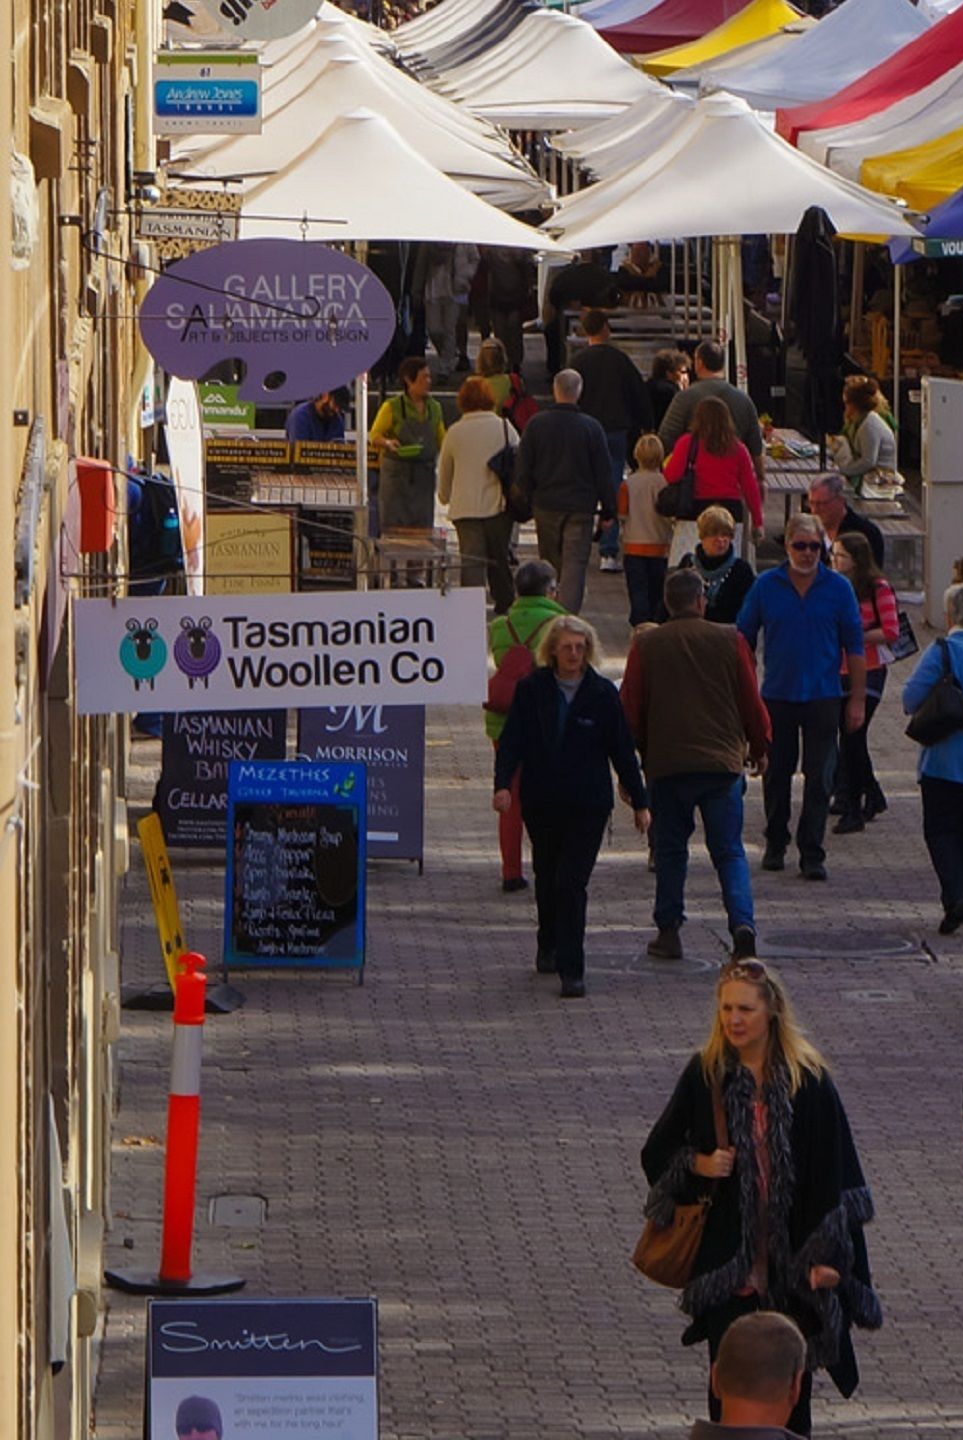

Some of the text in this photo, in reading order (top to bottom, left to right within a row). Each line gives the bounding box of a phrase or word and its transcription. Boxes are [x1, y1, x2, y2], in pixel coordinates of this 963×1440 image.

[165, 86, 211, 100] Andrew
[147, 222, 231, 238] TASMANIAN
[223, 273, 369, 302] GALLERY
[166, 302, 369, 330] SALAMANCA
[224, 330, 289, 342] OBJECTS
[291, 330, 312, 342] OF
[315, 330, 369, 342] DESIGN
[223, 612, 434, 649] Tasmanian
[227, 650, 445, 689] Woollen Co
[173, 712, 273, 738] TASMANIAN
[186, 735, 259, 760] WHISKY
[315, 746, 408, 762] MORRISON
[238, 765, 331, 781] MEZETHES
[160, 1321, 362, 1353] Smitten
